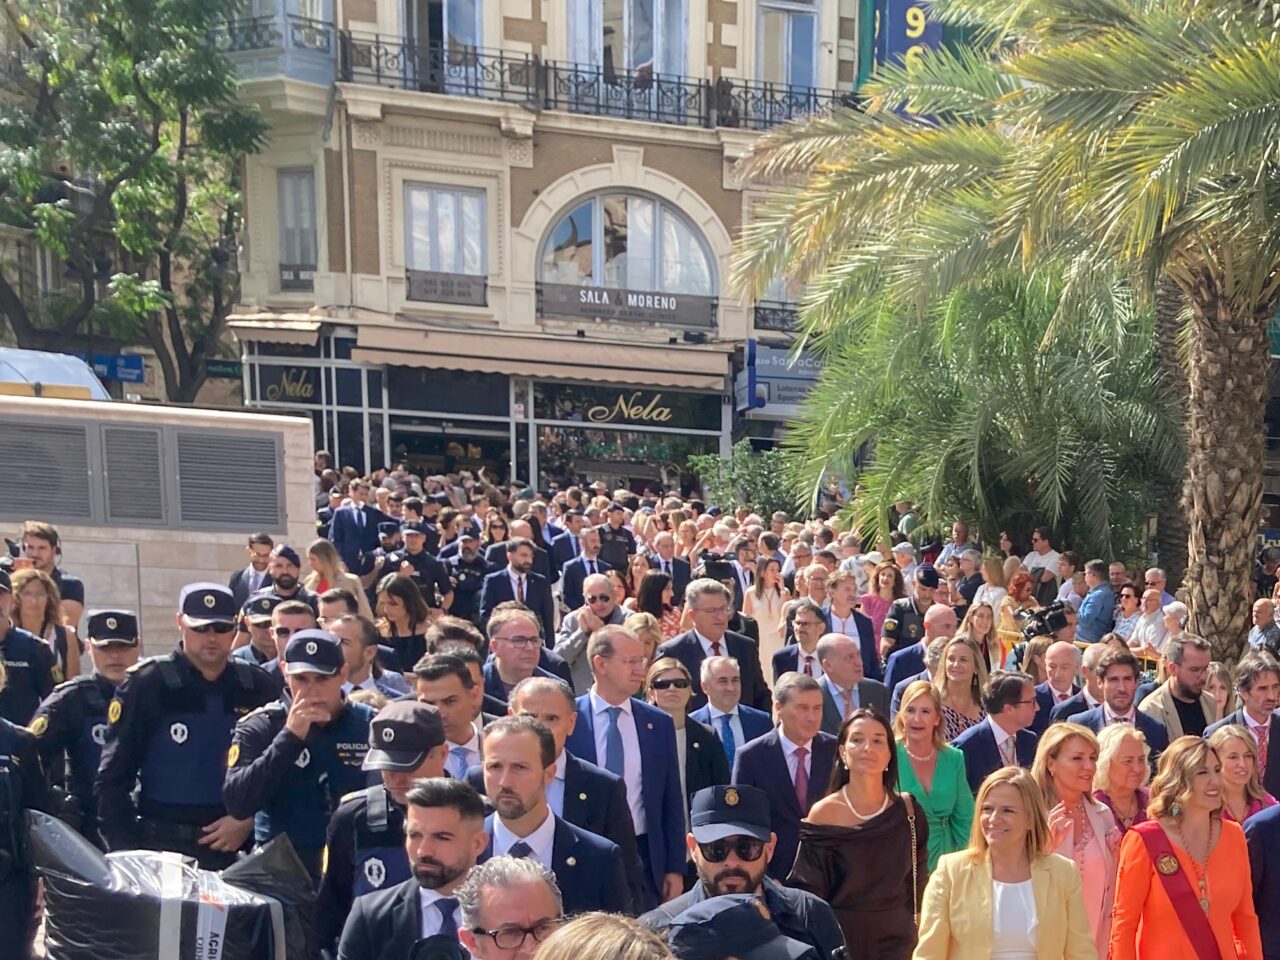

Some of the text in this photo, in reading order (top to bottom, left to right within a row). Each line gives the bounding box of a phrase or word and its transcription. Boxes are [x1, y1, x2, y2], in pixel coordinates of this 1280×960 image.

[579, 290, 610, 305] SALA
[627, 294, 677, 310] MORENO
[266, 368, 315, 400] Nela
[588, 392, 672, 423] Nela
